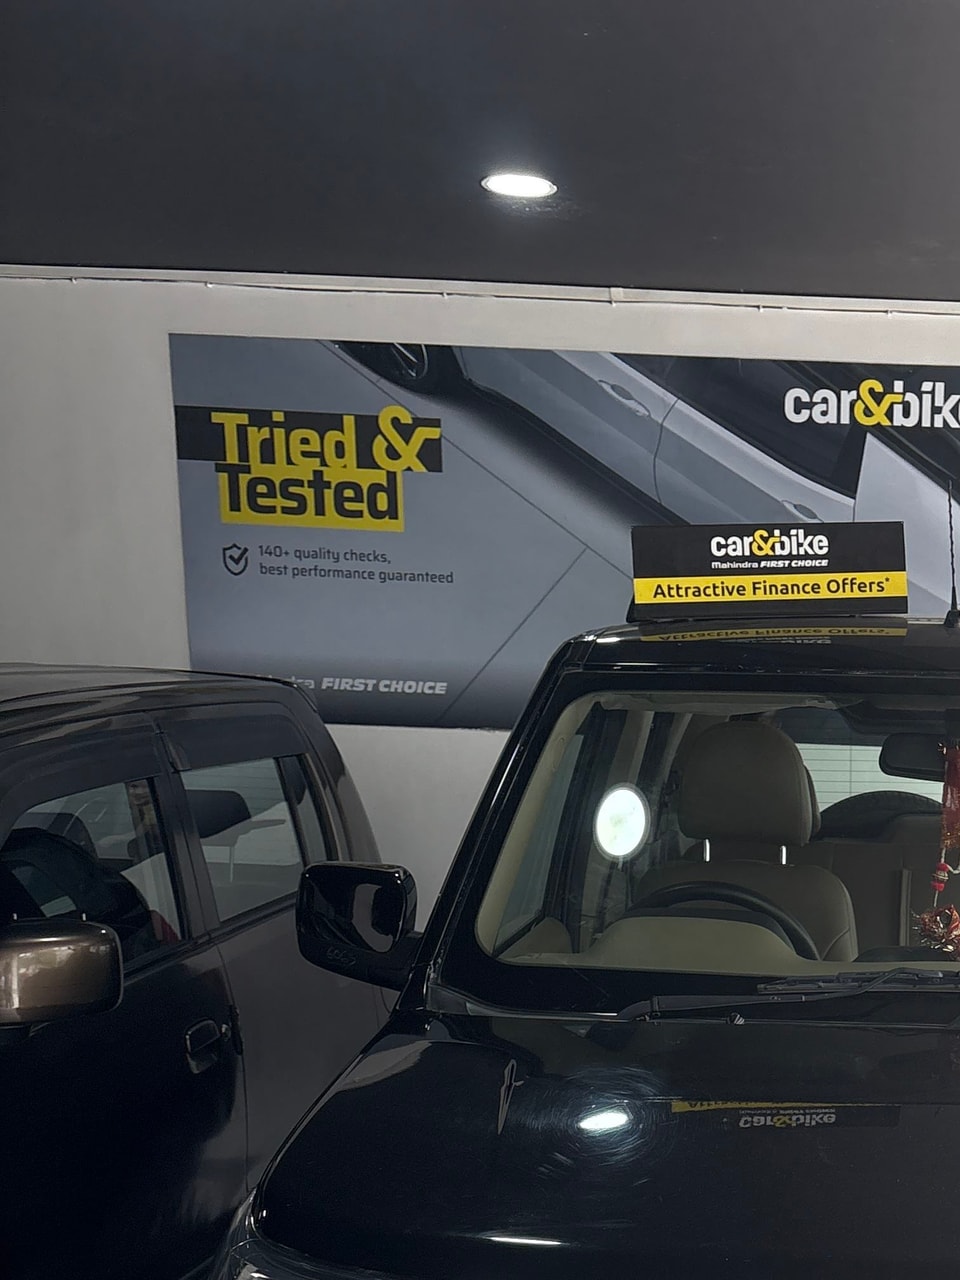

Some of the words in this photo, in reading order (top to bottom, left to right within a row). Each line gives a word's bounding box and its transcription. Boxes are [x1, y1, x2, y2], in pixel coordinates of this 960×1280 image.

[211, 411, 357, 469] Tried
[372, 405, 441, 473] &
[215, 462, 399, 520] Tested
[710, 529, 829, 557] car&bike
[258, 545, 290, 558] 140+
[294, 547, 340, 563] quality
[343, 549, 391, 565] checks,
[711, 560, 759, 569] Mahindra
[760, 560, 790, 569] FIRST
[791, 559, 830, 568] CHOICE
[259, 563, 288, 576] best
[292, 565, 375, 580] performance
[379, 571, 454, 584] guaranteed
[653, 580, 747, 599] Attractive
[752, 579, 821, 596] Finance
[321, 677, 376, 692] FIRST
[379, 680, 448, 695] CHOICE
